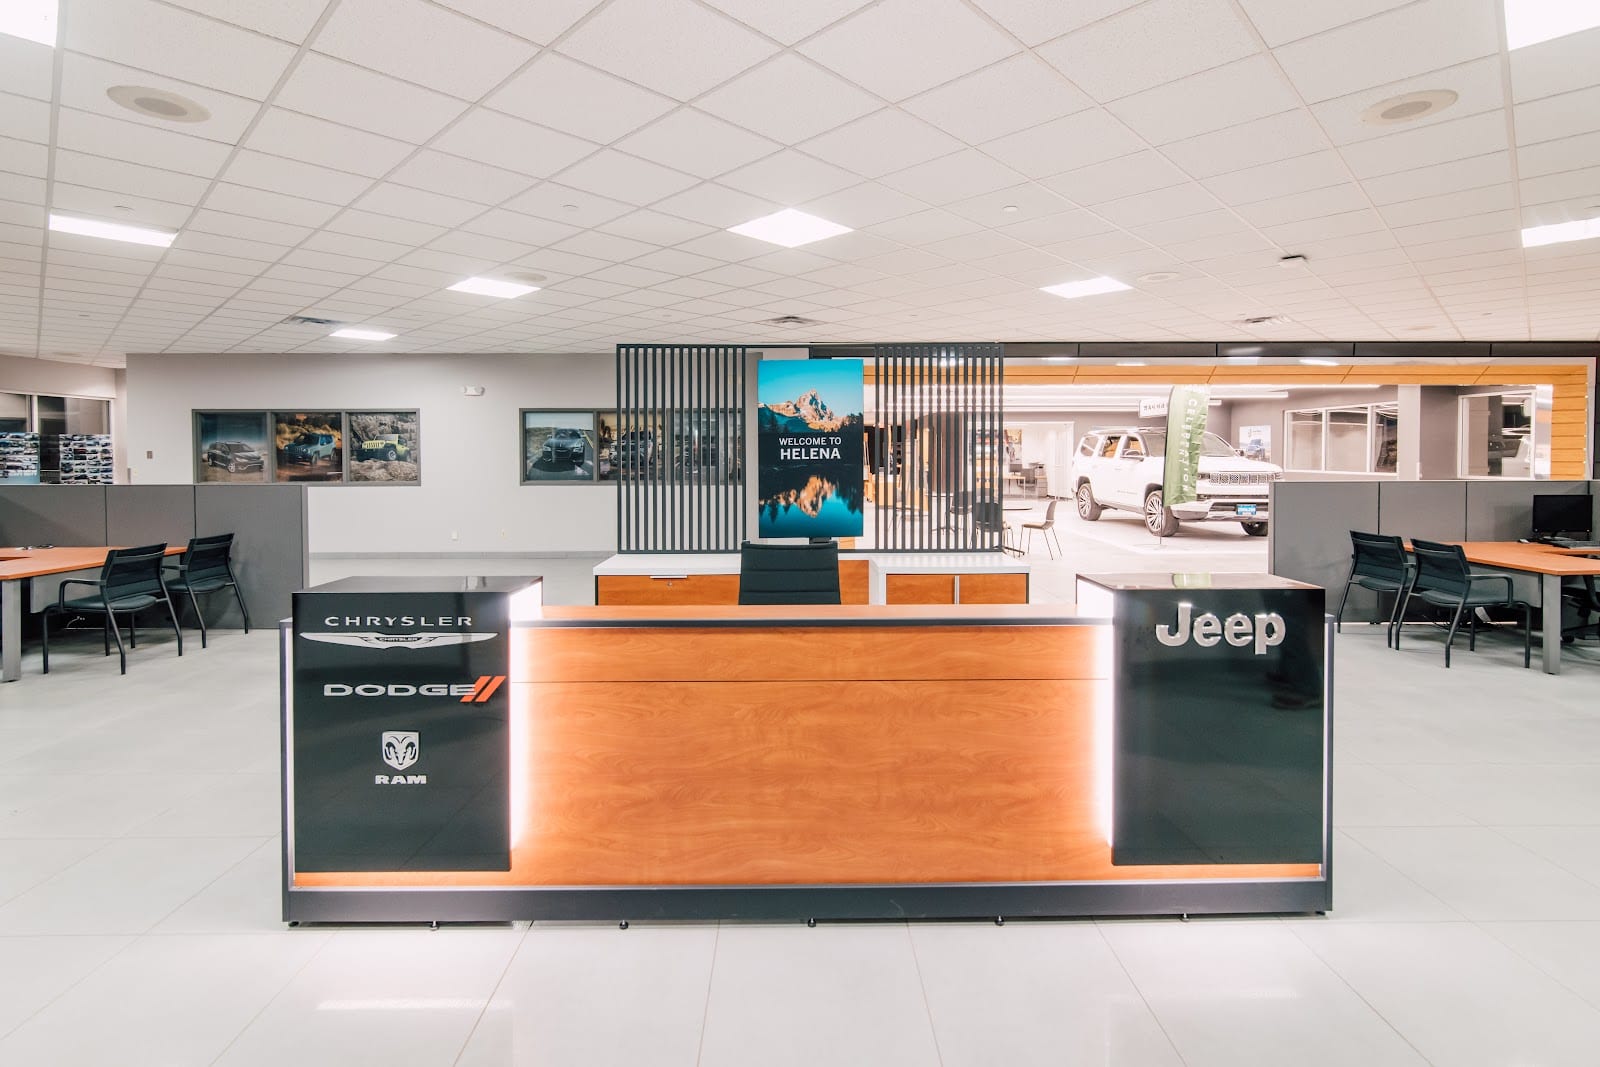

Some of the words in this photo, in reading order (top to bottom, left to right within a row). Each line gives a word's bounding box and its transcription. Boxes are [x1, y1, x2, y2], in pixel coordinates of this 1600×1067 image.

[779, 437, 827, 446] WELCOME
[829, 437, 842, 445] TO
[780, 448, 841, 460] HELENA
[324, 616, 473, 626] CHRYSLER
[1155, 602, 1286, 655] Jeep
[323, 684, 477, 697] DODGE
[374, 775, 427, 785] RAM
